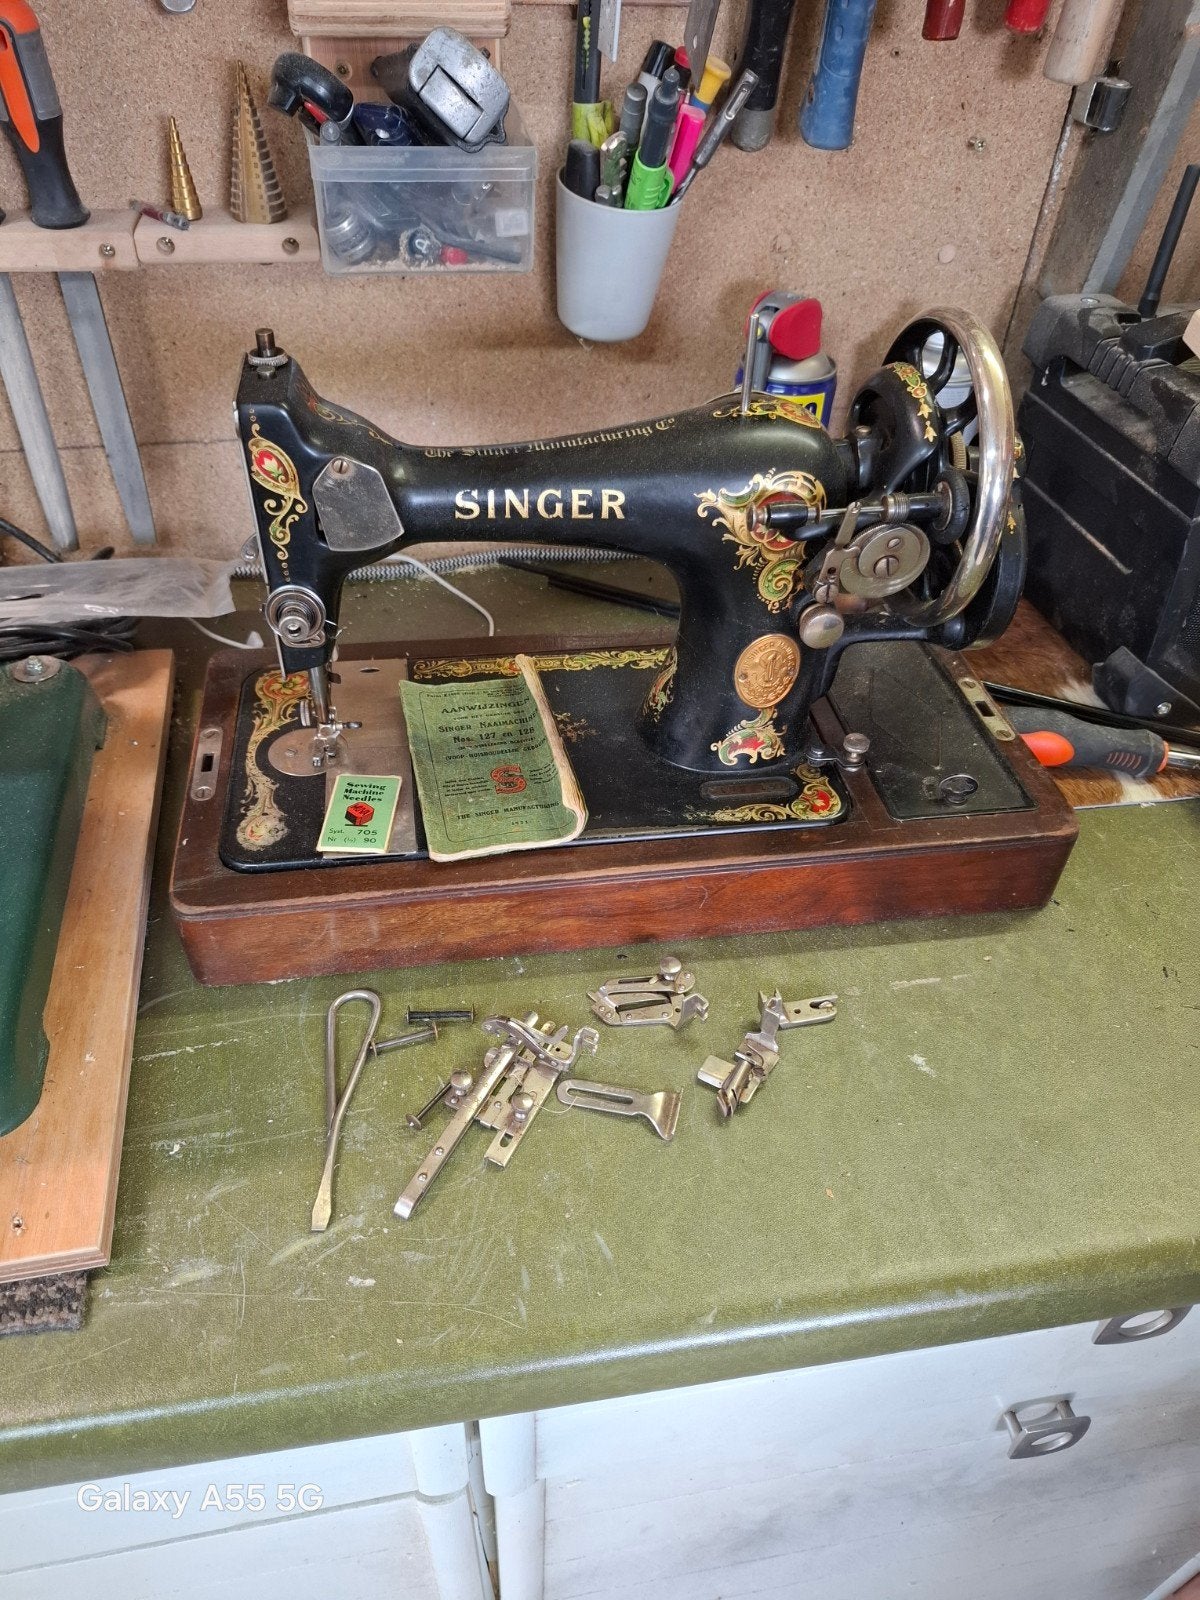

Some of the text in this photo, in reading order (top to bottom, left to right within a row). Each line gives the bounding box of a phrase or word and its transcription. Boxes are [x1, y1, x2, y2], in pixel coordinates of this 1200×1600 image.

[527, 425, 653, 453] Manufacturing
[454, 488, 626, 520] SINGER
[441, 698, 530, 714] AANWIJZINGEN
[438, 724, 472, 733] SINGER
[479, 732, 496, 740] 127
[346, 782, 386, 791] Sewing
[343, 788, 384, 796] Machine
[342, 794, 383, 802] Needles
[475, 809, 500, 817] SINGER
